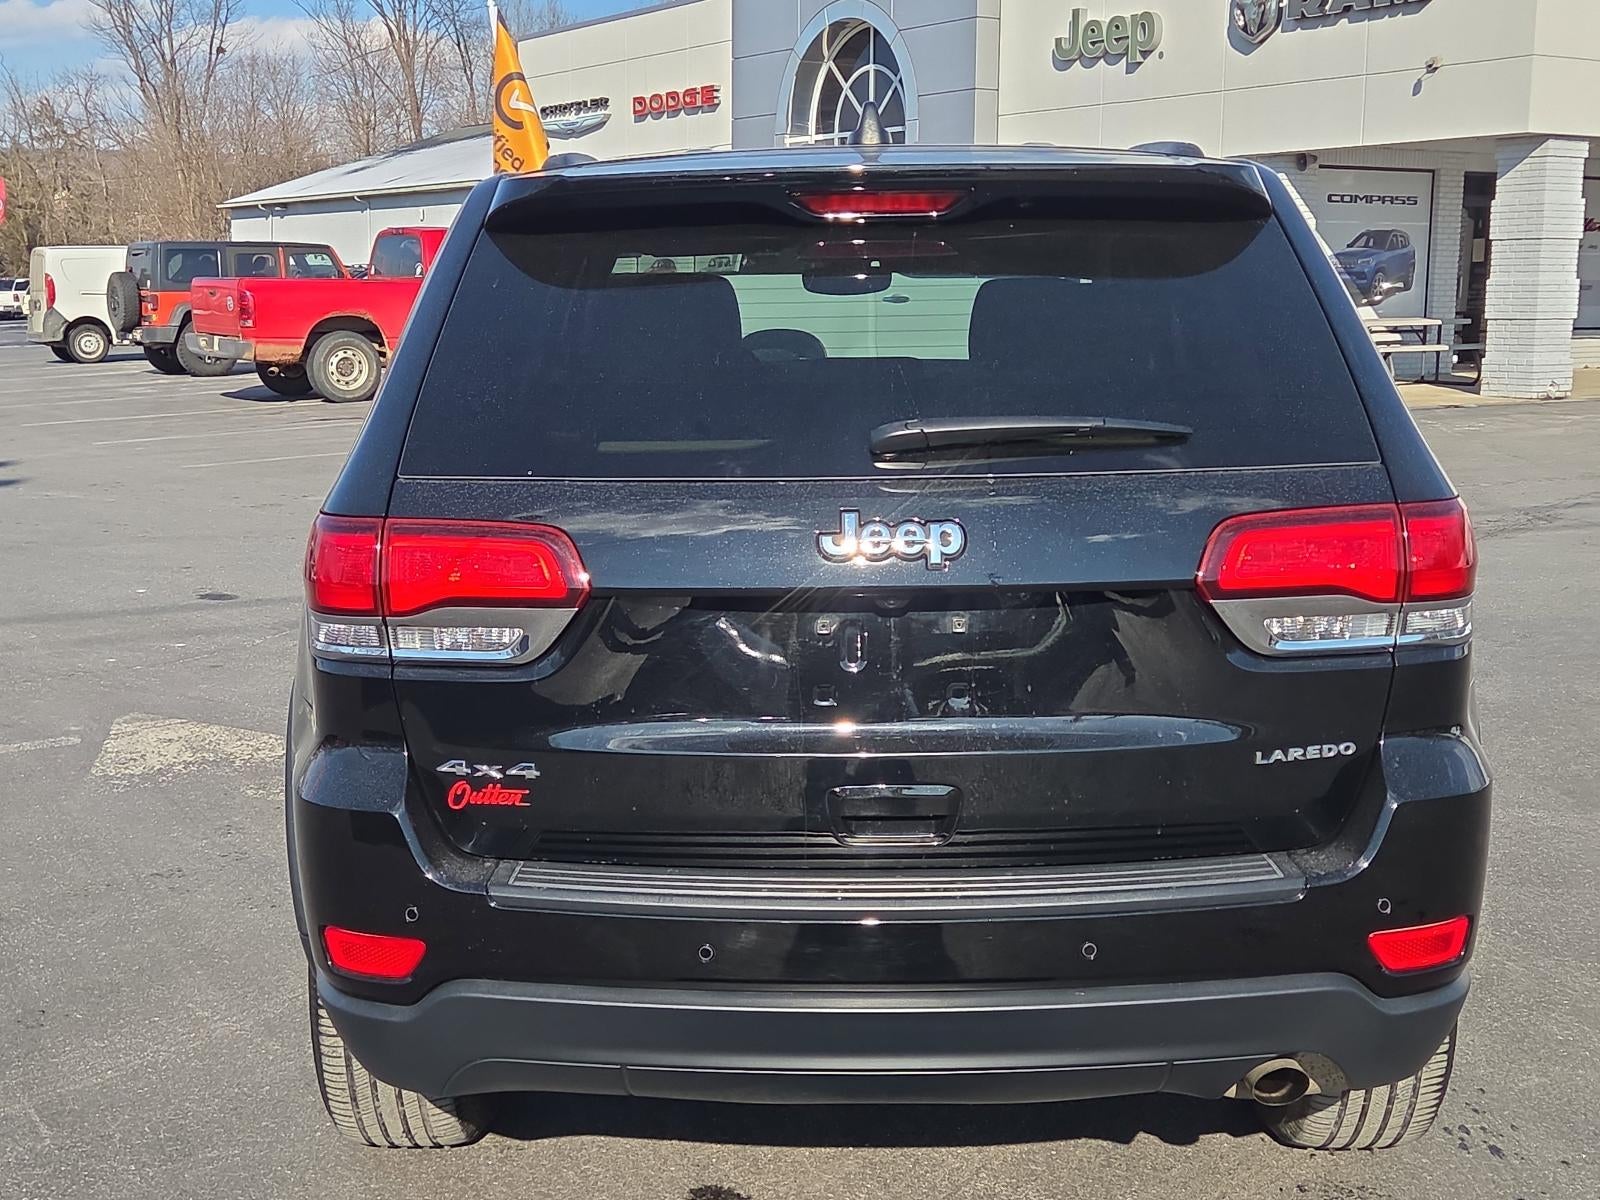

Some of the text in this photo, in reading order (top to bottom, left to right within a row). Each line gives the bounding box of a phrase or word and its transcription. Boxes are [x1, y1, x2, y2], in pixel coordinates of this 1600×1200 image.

[1054, 8, 1163, 63] Jeep
[632, 84, 720, 116] DODGE
[1327, 192, 1419, 206] COMPASS
[816, 507, 968, 571] Jeep
[1255, 741, 1357, 765] LAREDO
[447, 780, 532, 810] Outten
